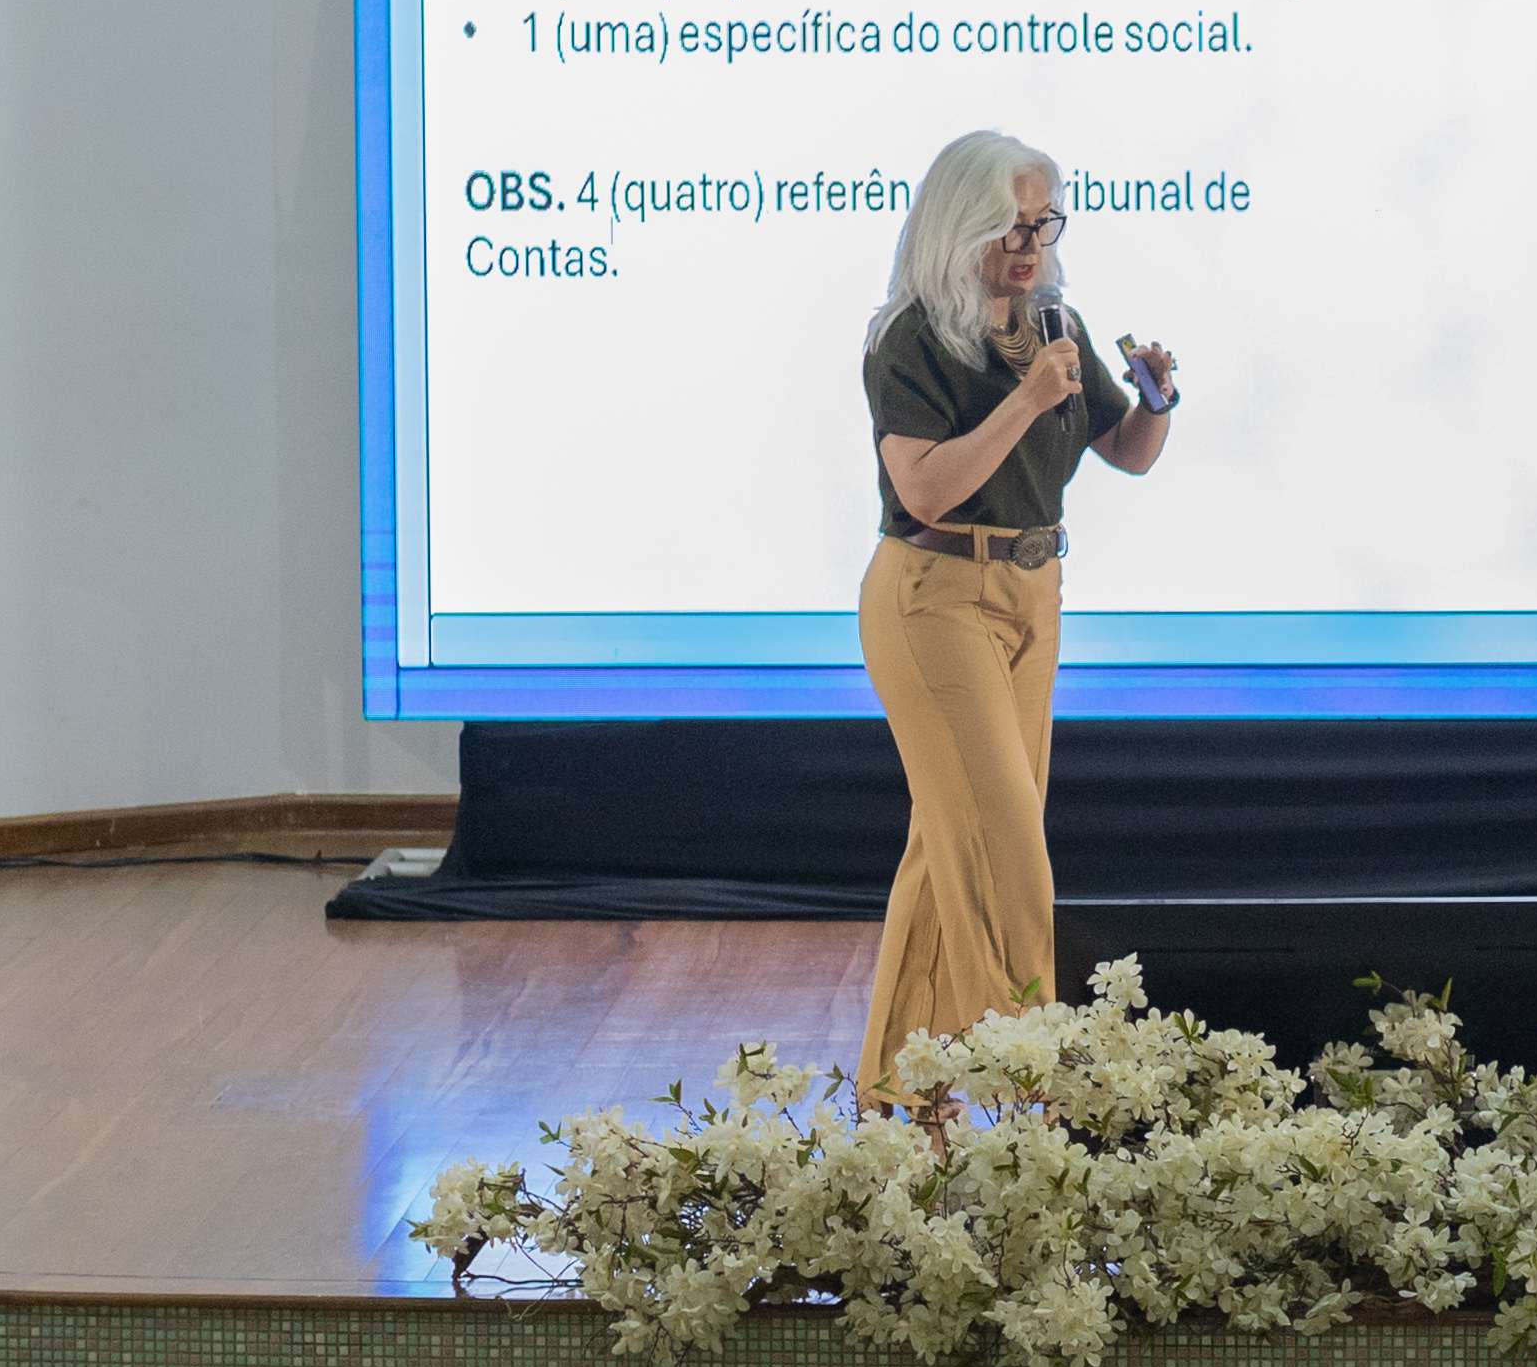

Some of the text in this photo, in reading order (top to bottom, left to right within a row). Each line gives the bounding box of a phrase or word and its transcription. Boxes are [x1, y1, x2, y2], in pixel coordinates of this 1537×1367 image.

[522, 8, 1253, 65] 1 (uma) específica do controle social.
[464, 169, 566, 213] OBS.
[575, 170, 600, 213] 4
[611, 170, 765, 223] (quatro)
[775, 167, 911, 213] referên
[1204, 169, 1251, 213] de
[465, 233, 619, 278] Contas.
